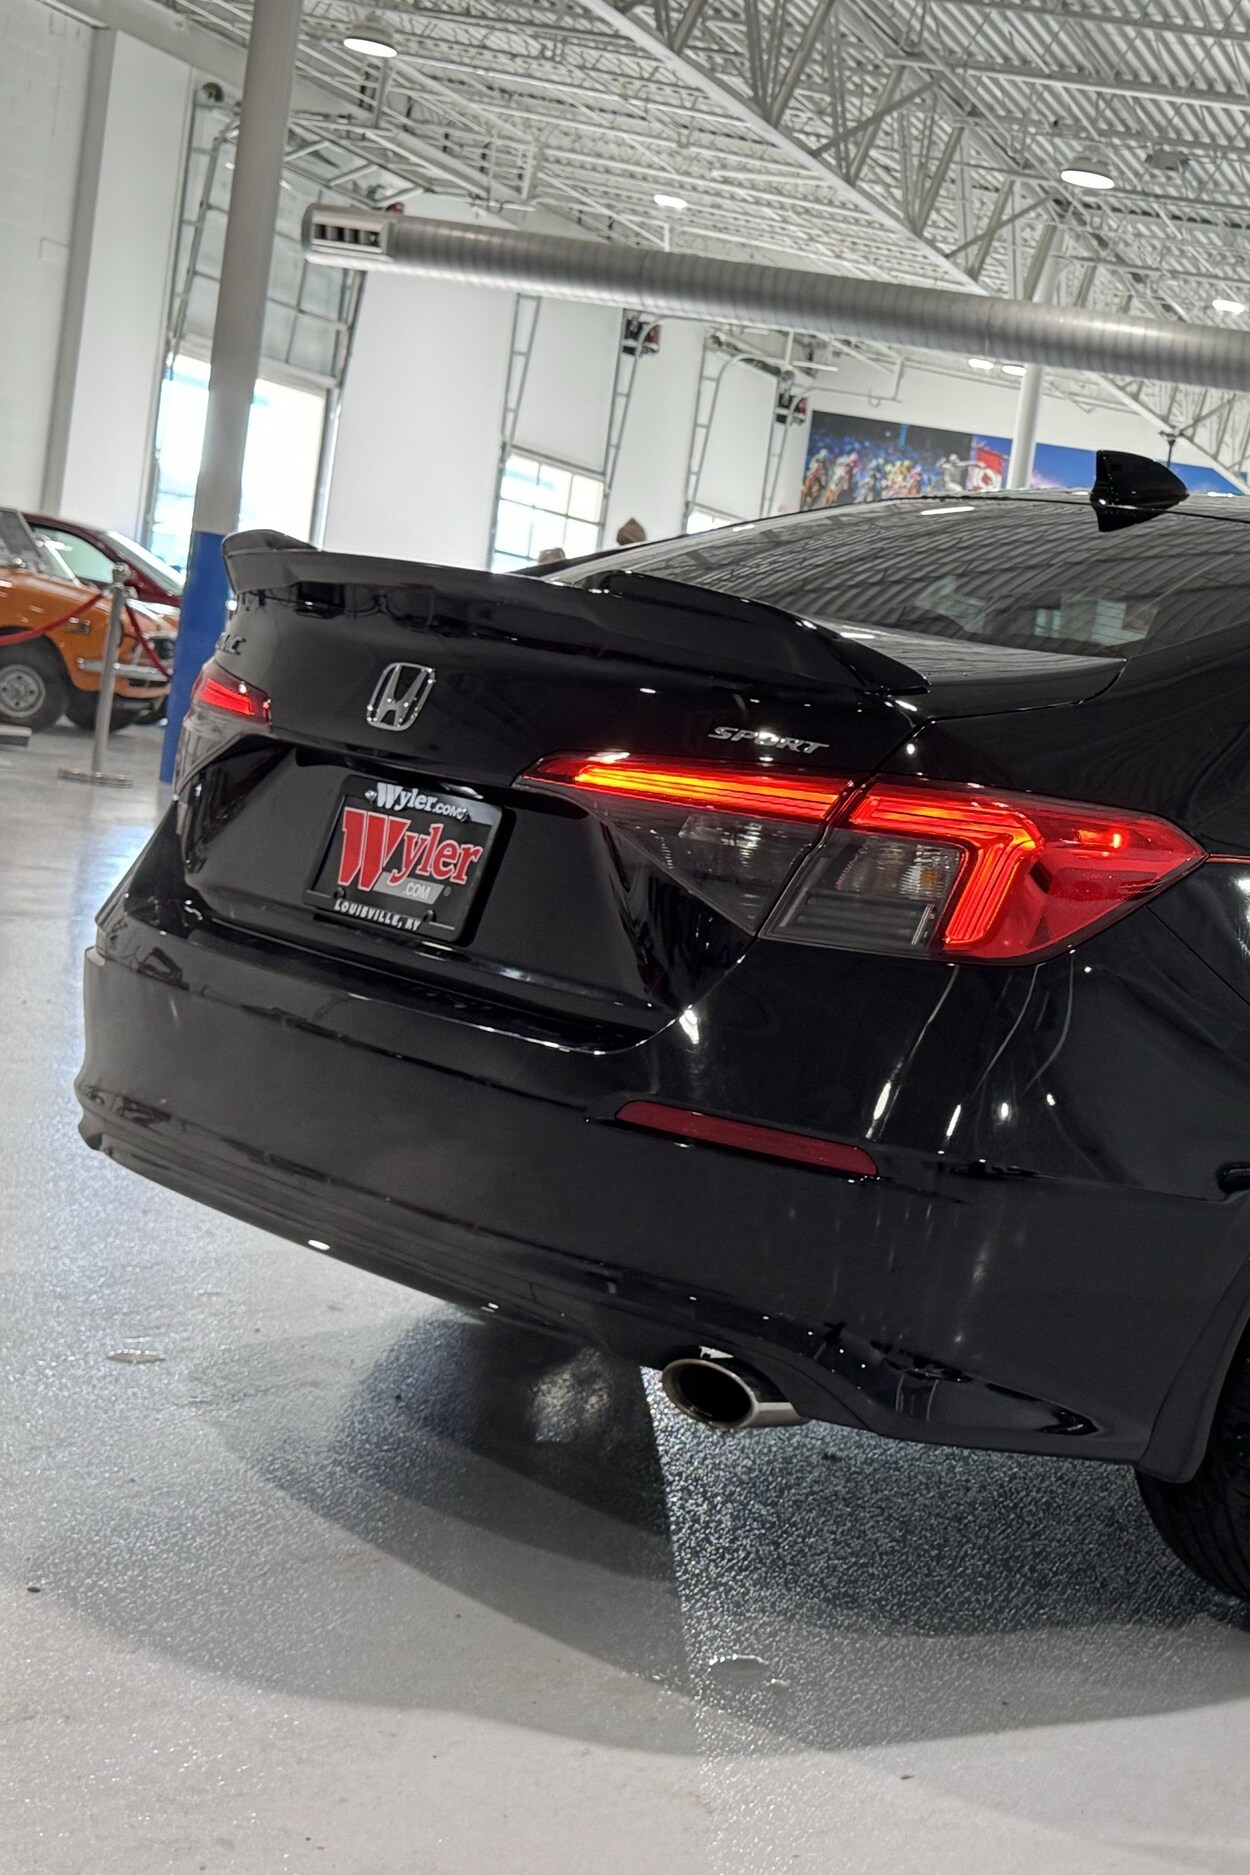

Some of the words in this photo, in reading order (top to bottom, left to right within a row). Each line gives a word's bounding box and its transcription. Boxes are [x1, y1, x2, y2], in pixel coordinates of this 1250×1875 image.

[708, 726, 830, 754] SPORT
[338, 807, 483, 891] Wyler
[403, 883, 431, 900] .COM
[334, 900, 402, 928] LOUISVILLE,
[405, 917, 421, 931] KY
